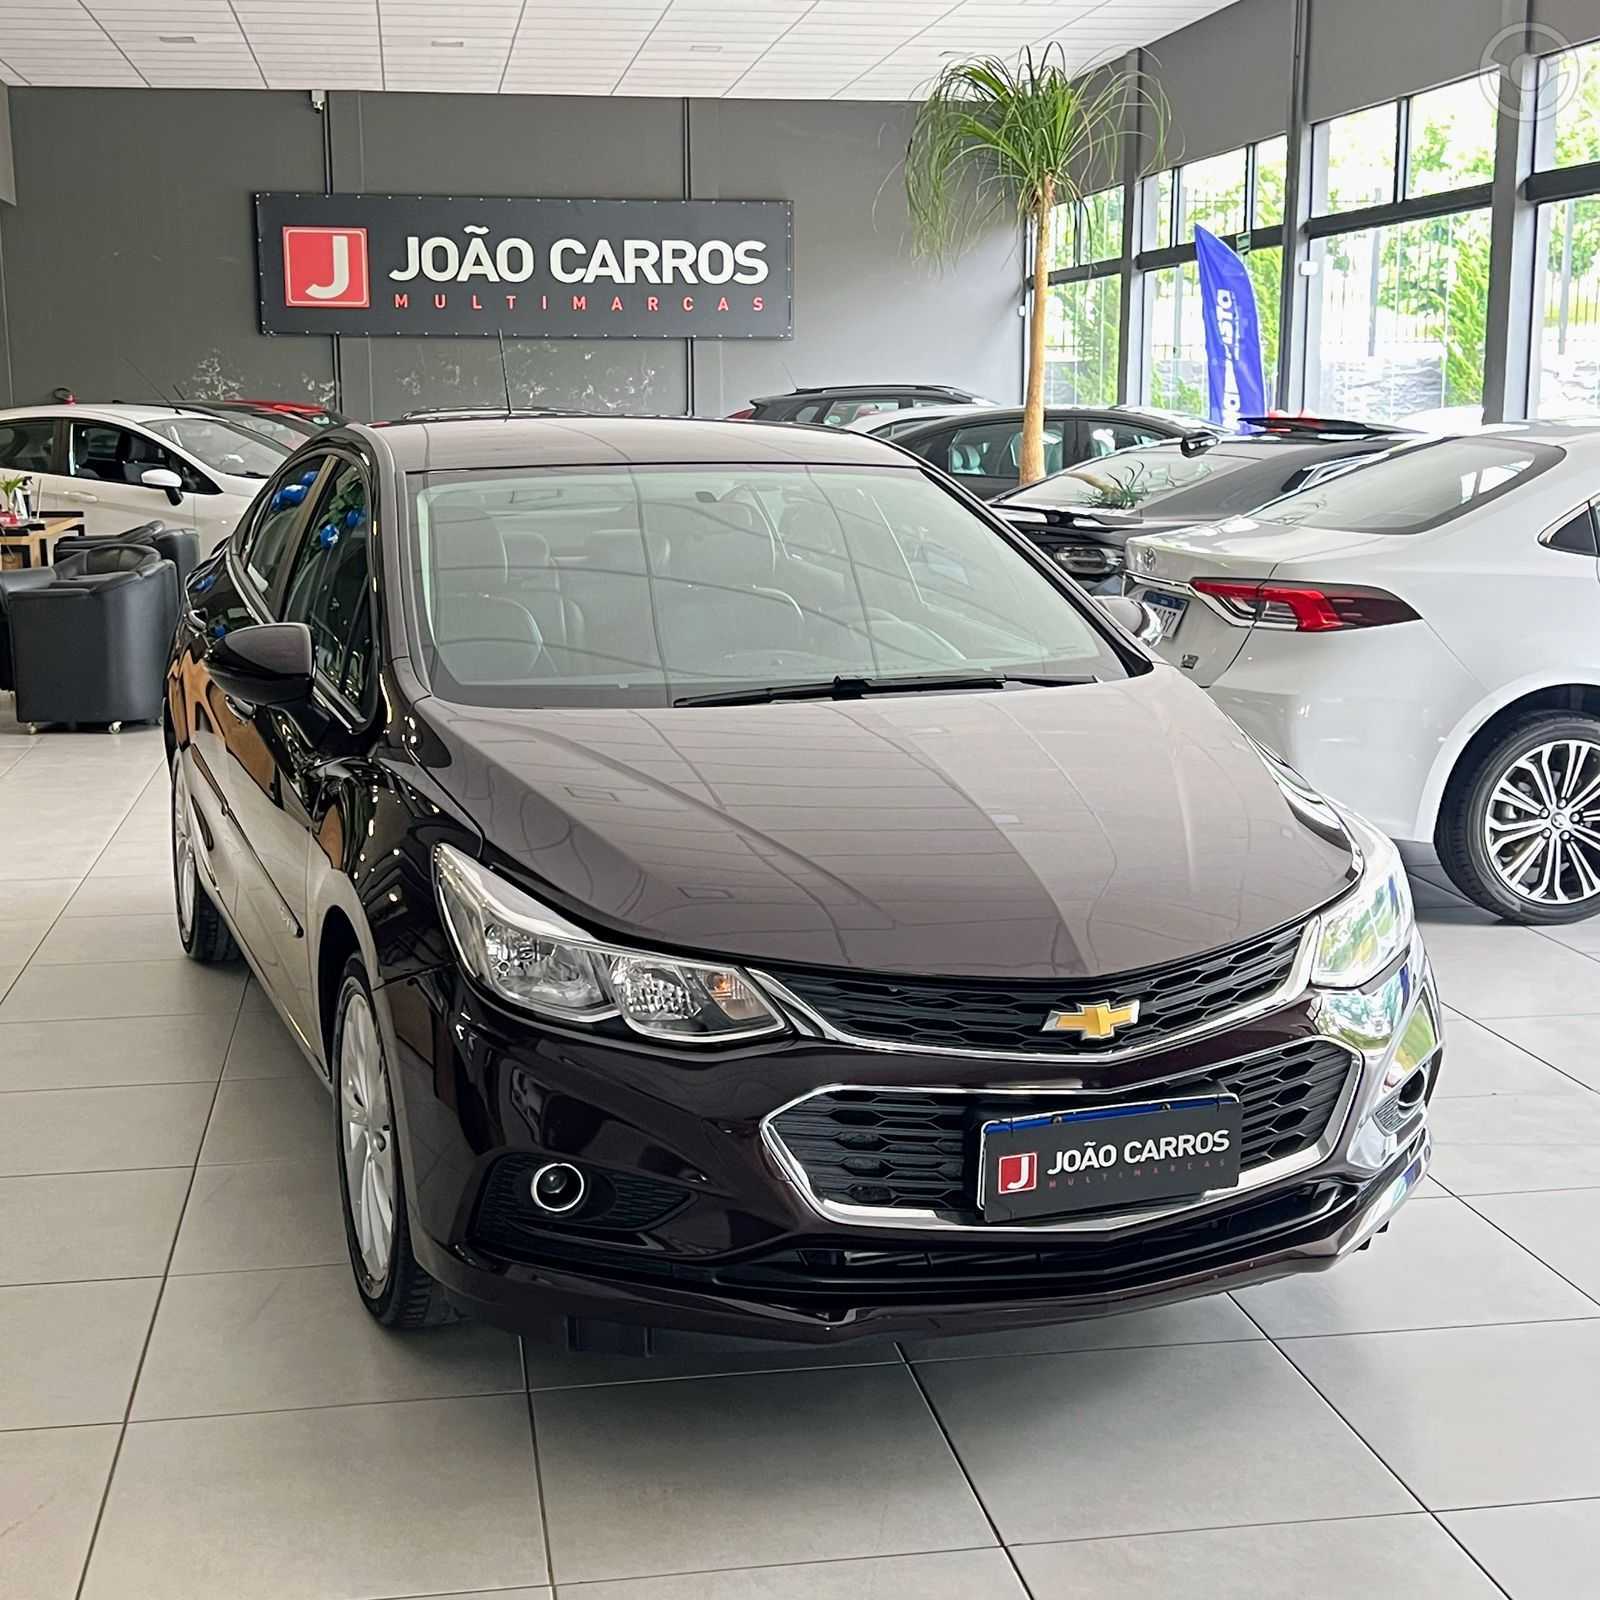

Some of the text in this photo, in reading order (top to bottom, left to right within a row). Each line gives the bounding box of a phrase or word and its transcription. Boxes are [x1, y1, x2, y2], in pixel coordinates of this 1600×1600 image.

[304, 234, 349, 300] J
[388, 224, 769, 286] JOÃO CARROS
[394, 293, 765, 312] MULTIMARCAS
[1047, 1129, 1230, 1175] JOÃO CARROS
[1007, 1156, 1030, 1190] J
[1049, 1159, 1226, 1189] MULTIMARCAS
